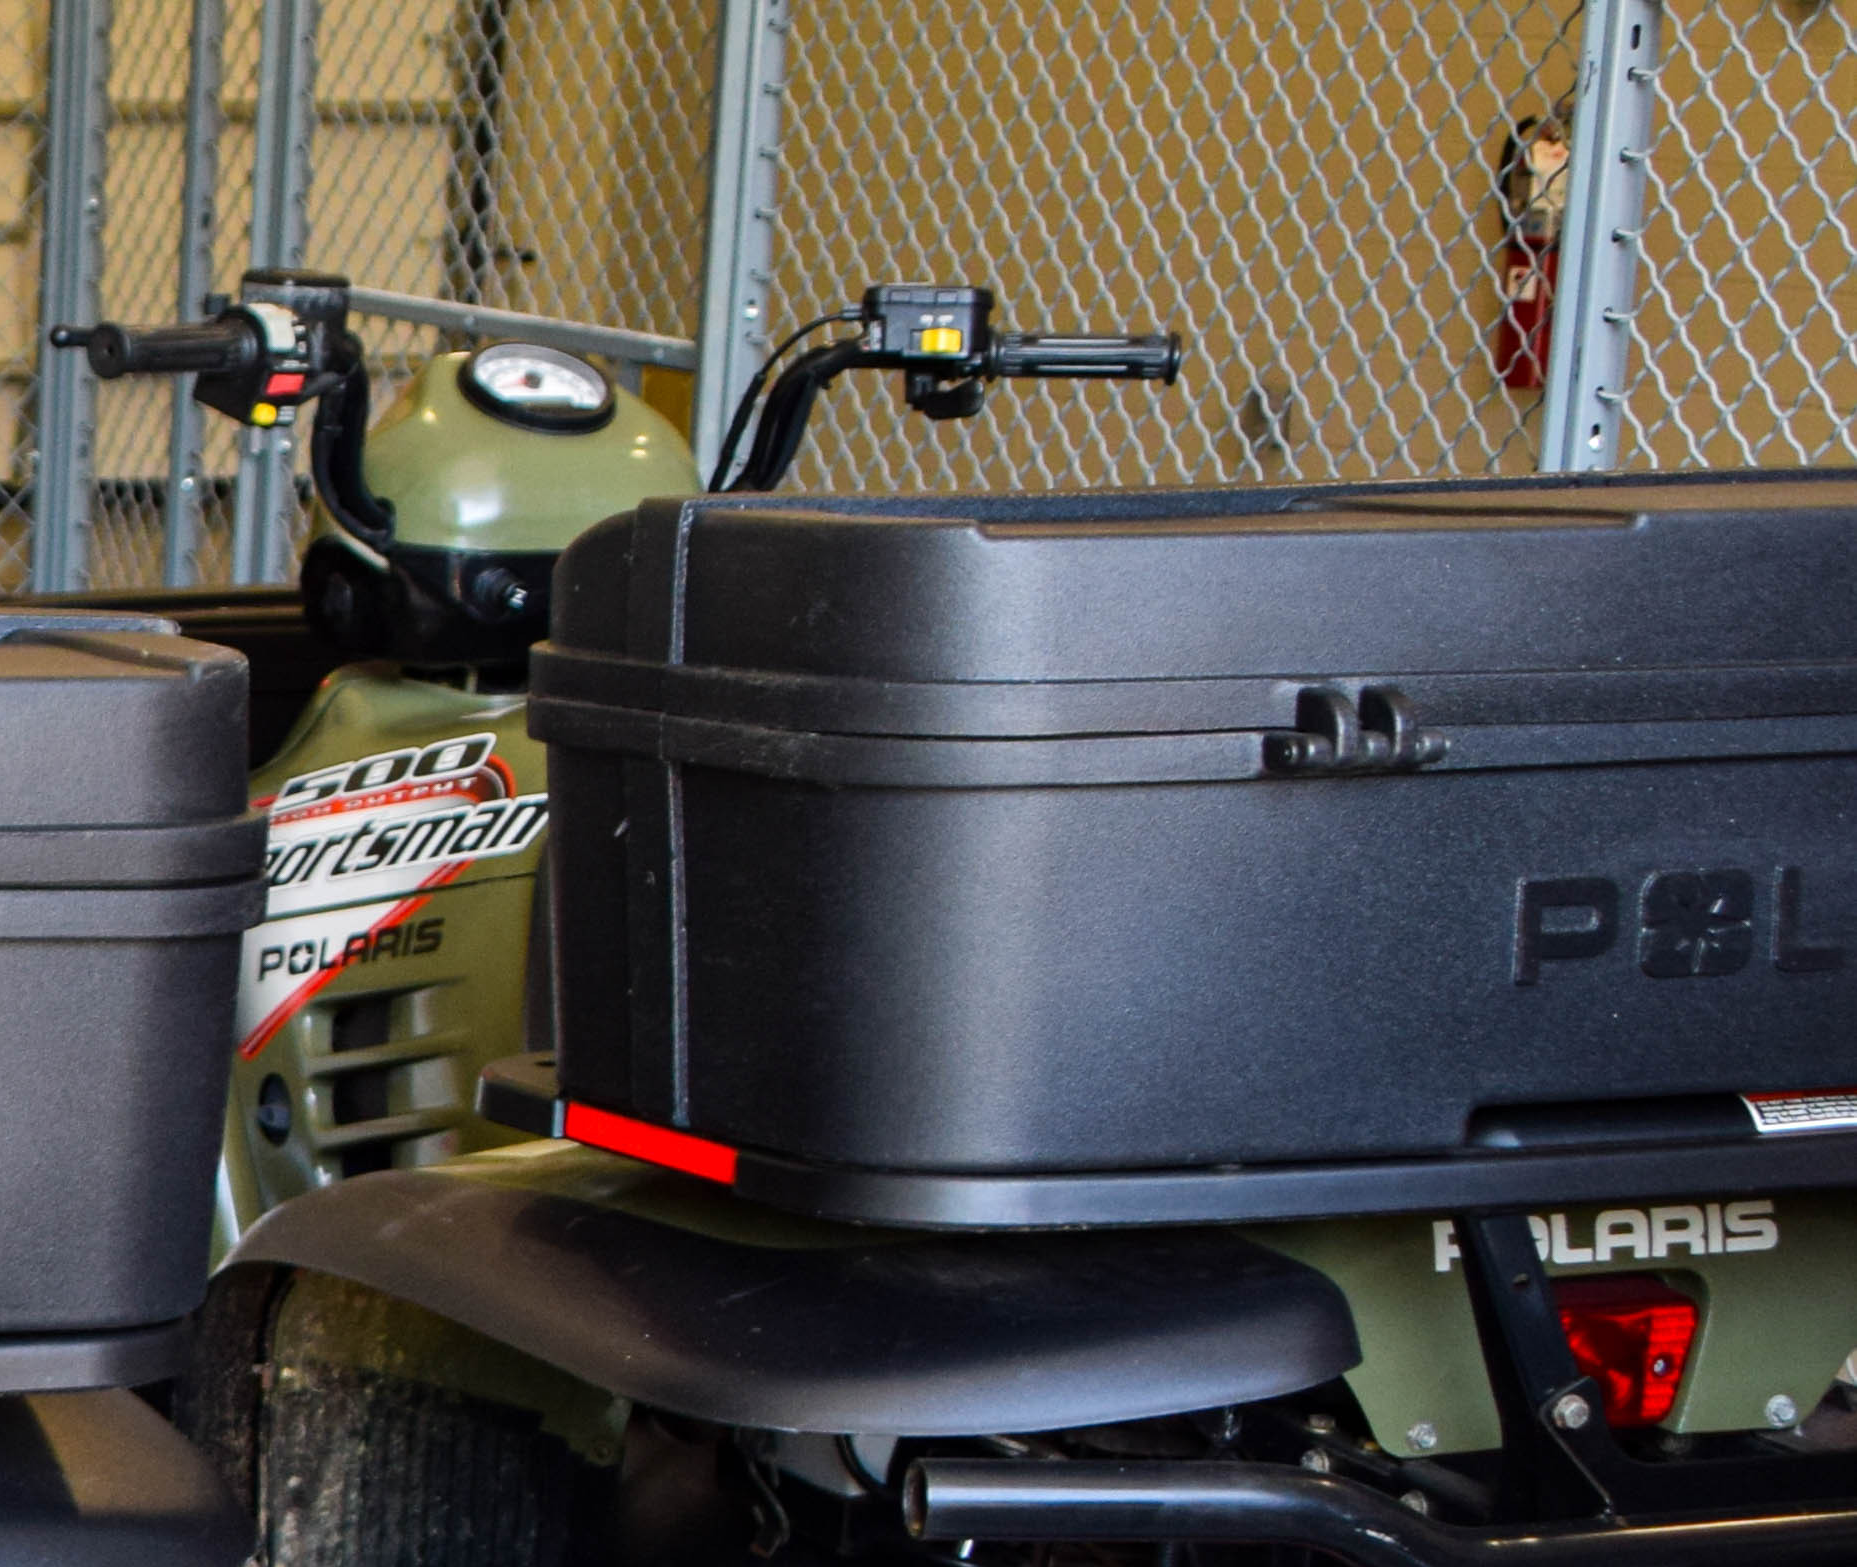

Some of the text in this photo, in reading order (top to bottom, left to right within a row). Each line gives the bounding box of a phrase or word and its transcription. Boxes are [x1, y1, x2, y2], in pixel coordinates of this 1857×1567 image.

[274, 733, 497, 811] 500
[341, 777, 478, 809] OUTPUT
[266, 797, 549, 888] ortsman
[257, 917, 445, 981] POLARIS
[1432, 1200, 1779, 1272] PLARIS
